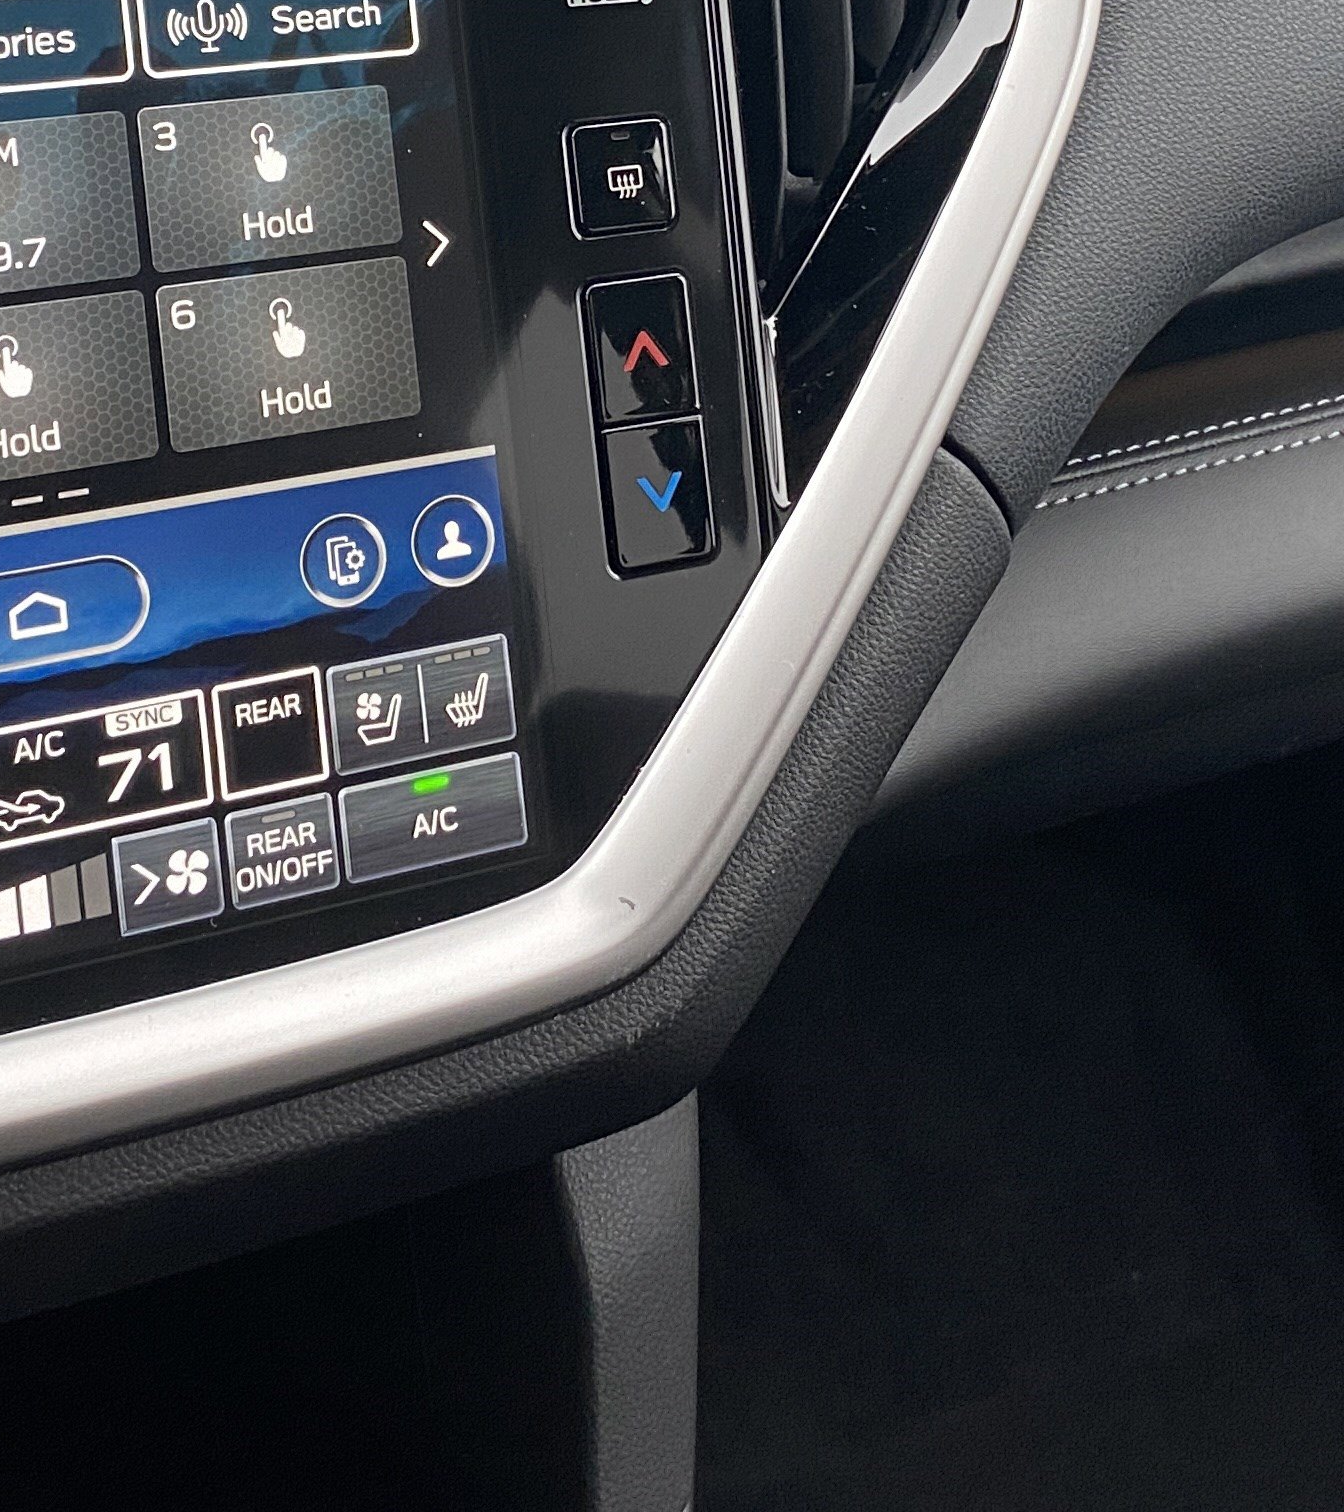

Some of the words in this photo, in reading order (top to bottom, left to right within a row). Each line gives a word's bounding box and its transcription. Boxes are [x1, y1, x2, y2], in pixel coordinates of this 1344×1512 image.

[153, 121, 177, 152] 3
[242, 205, 314, 241] Hold
[170, 300, 196, 330] 6
[261, 380, 332, 418] Hold
[115, 703, 174, 731] SYNC
[235, 693, 302, 728] REAR
[13, 731, 67, 765] A/C
[97, 742, 175, 803] 71
[246, 822, 316, 858] REAR
[412, 806, 459, 839] A/C
[236, 850, 333, 893] ON/OFF
